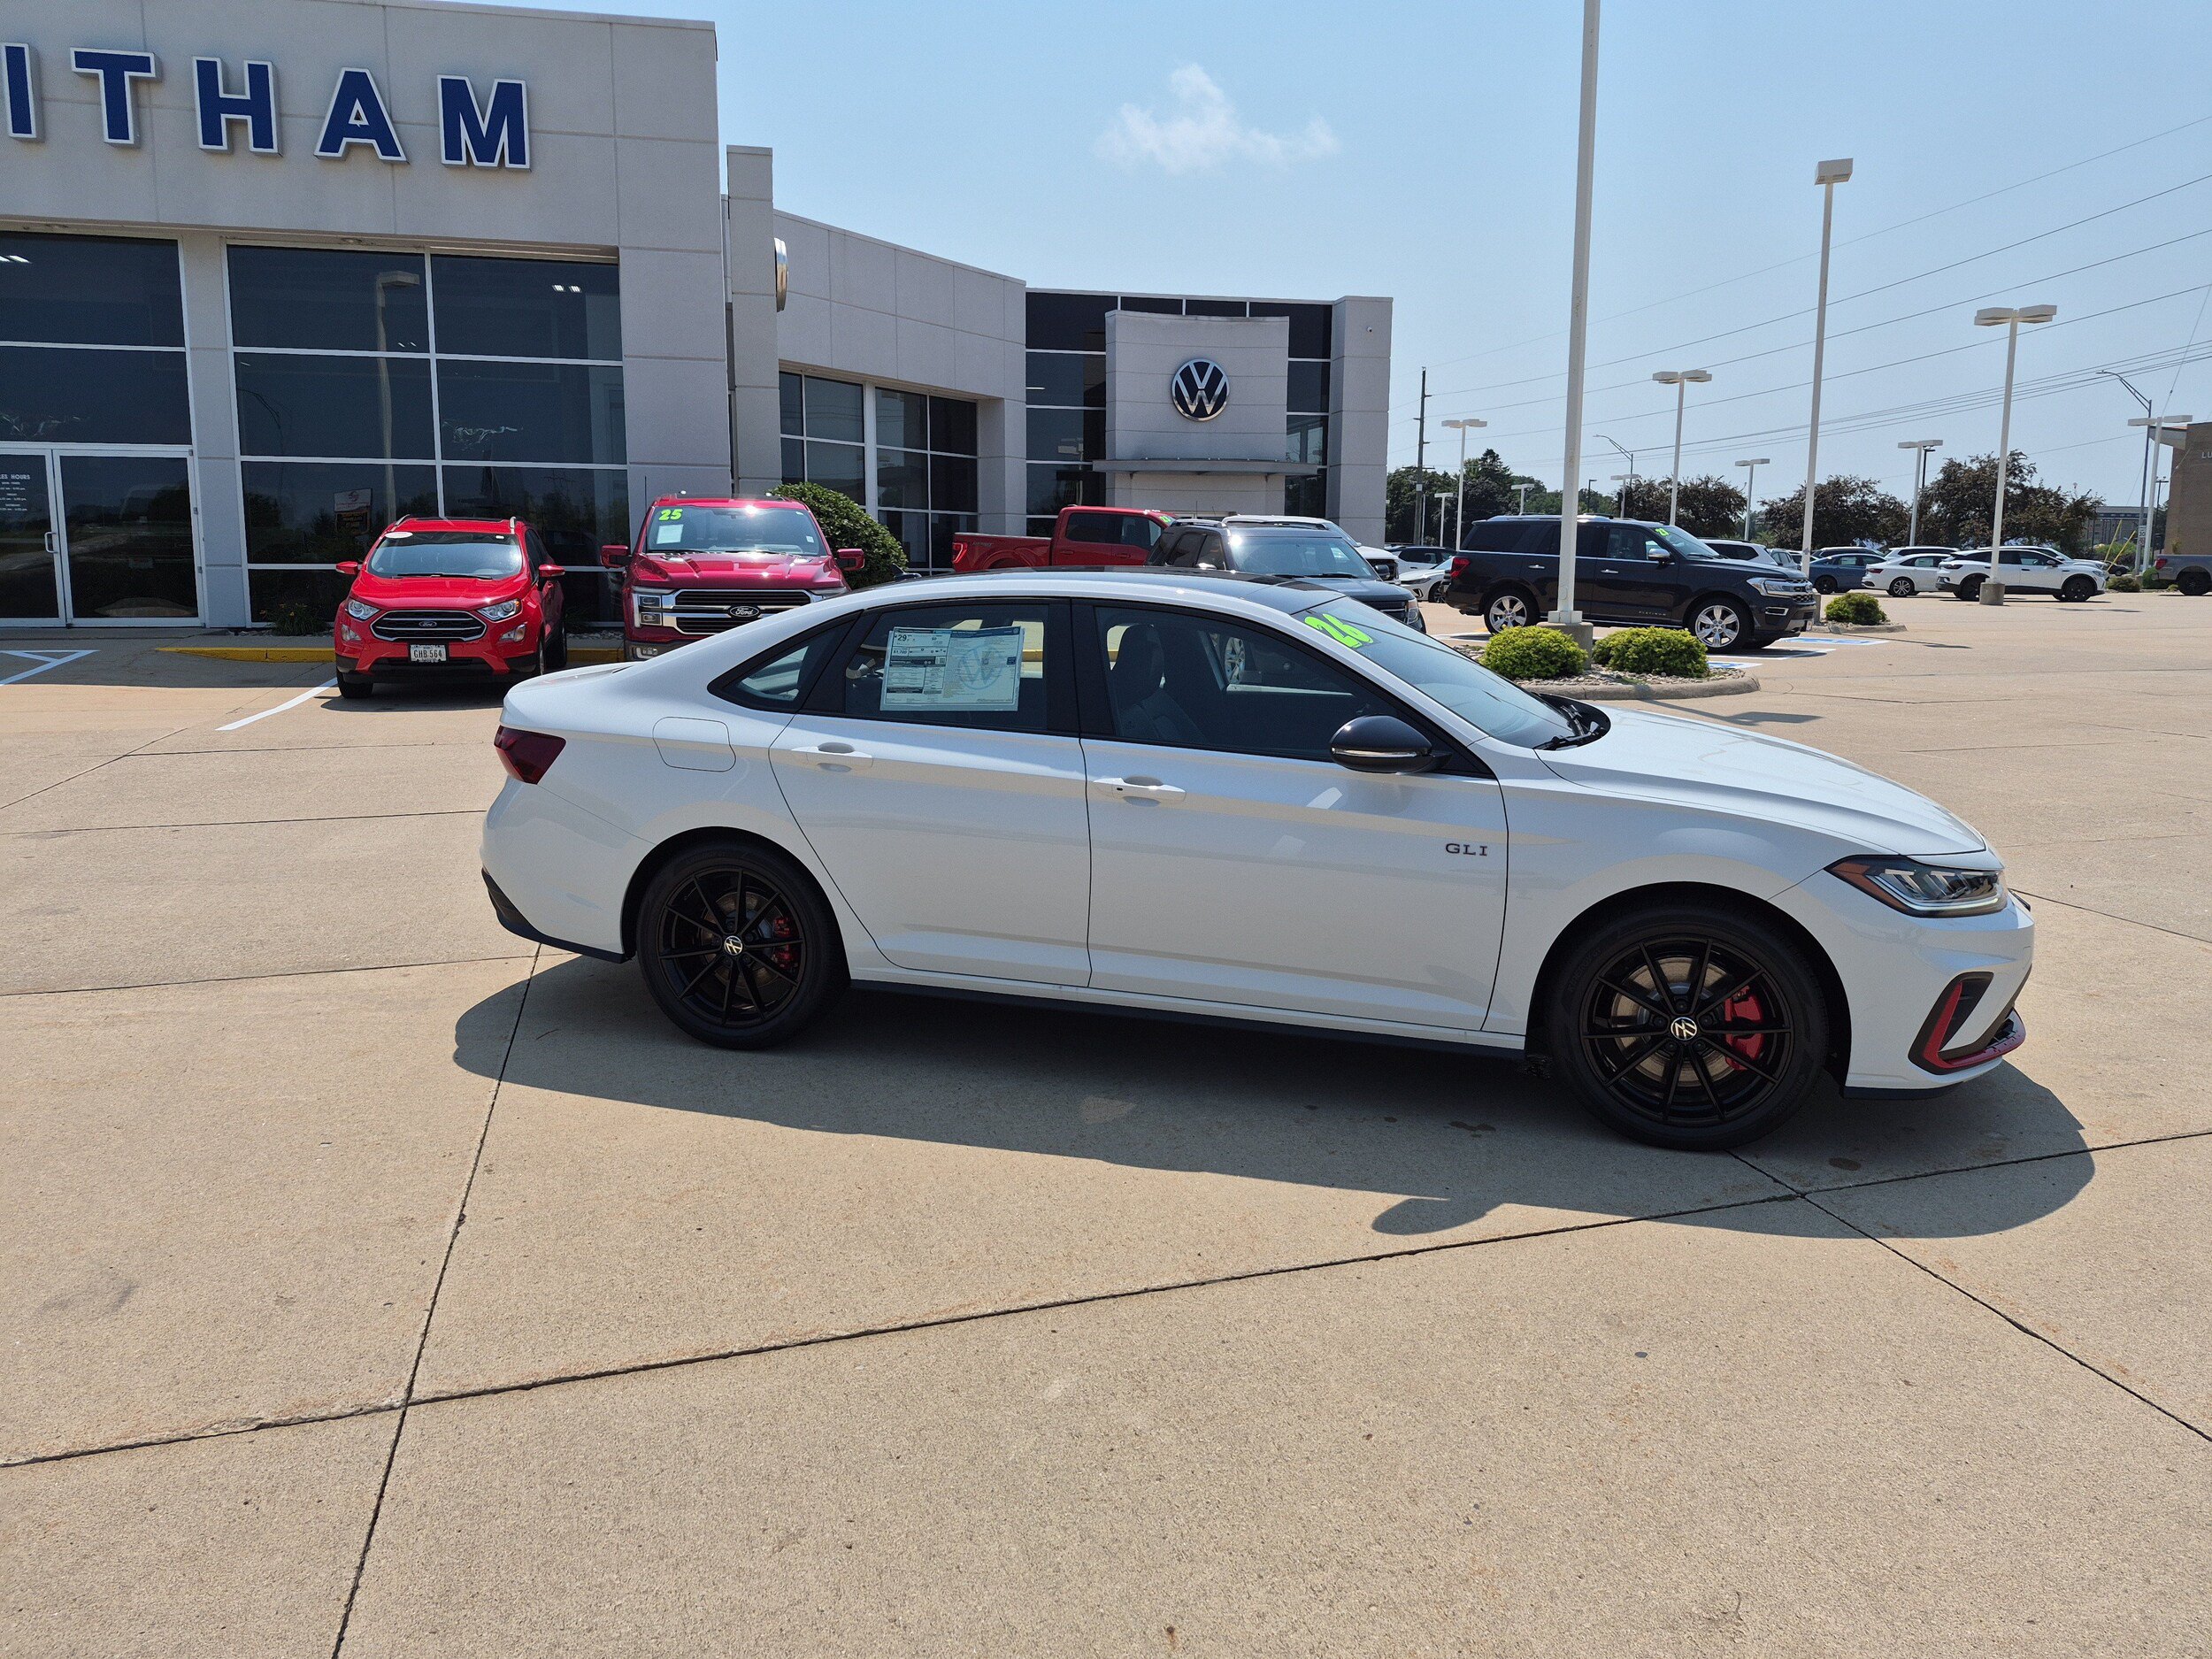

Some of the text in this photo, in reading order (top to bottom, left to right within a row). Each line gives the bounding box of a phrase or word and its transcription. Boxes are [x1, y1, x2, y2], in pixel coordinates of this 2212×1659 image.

[2, 42, 531, 170] ITHAM
[1171, 358, 1230, 421] VW
[659, 508, 683, 521] 25
[733, 607, 755, 616] Ford
[1304, 613, 1374, 649] 26
[413, 649, 442, 658] GHB 564
[1445, 842, 1487, 856] GLI
